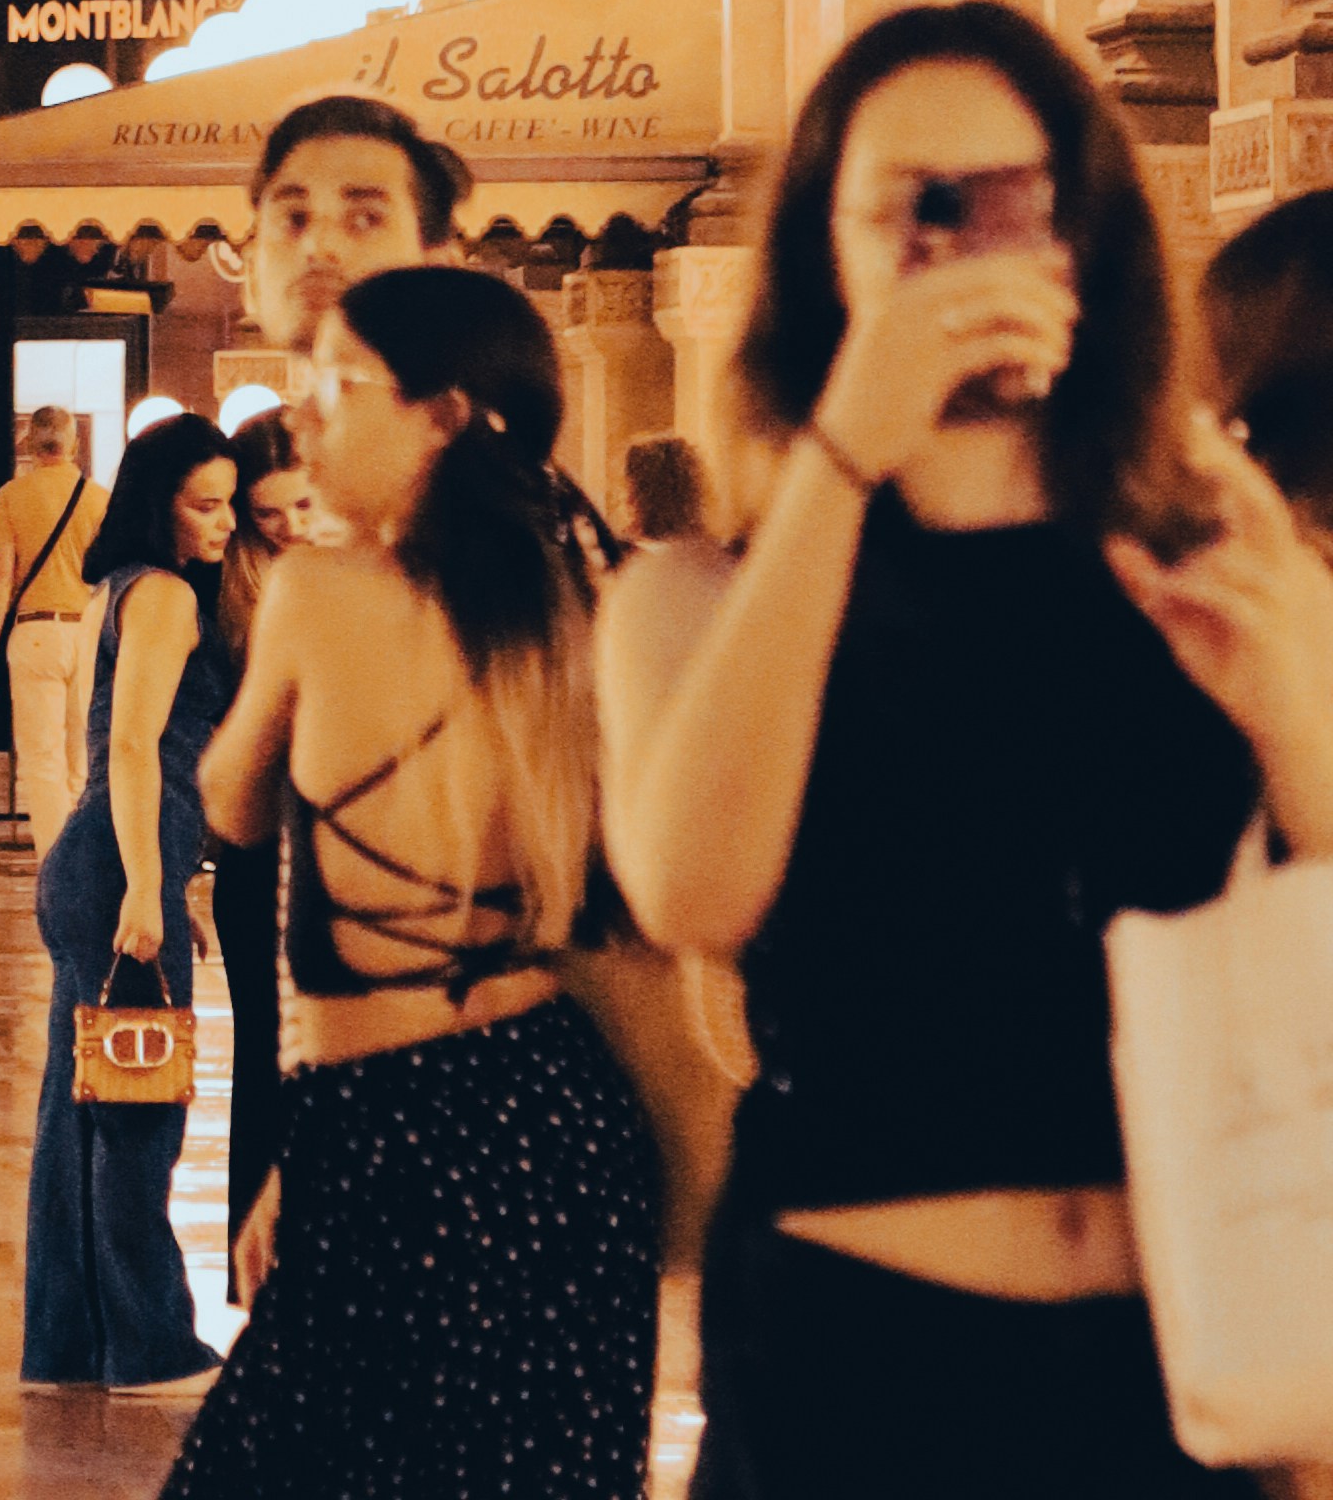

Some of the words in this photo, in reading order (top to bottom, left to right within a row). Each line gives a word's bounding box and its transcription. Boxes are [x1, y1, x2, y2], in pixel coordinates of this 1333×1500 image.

[422, 34, 661, 100] Salotto
[112, 122, 266, 146] RISTORAN
[582, 115, 662, 139] WINE
